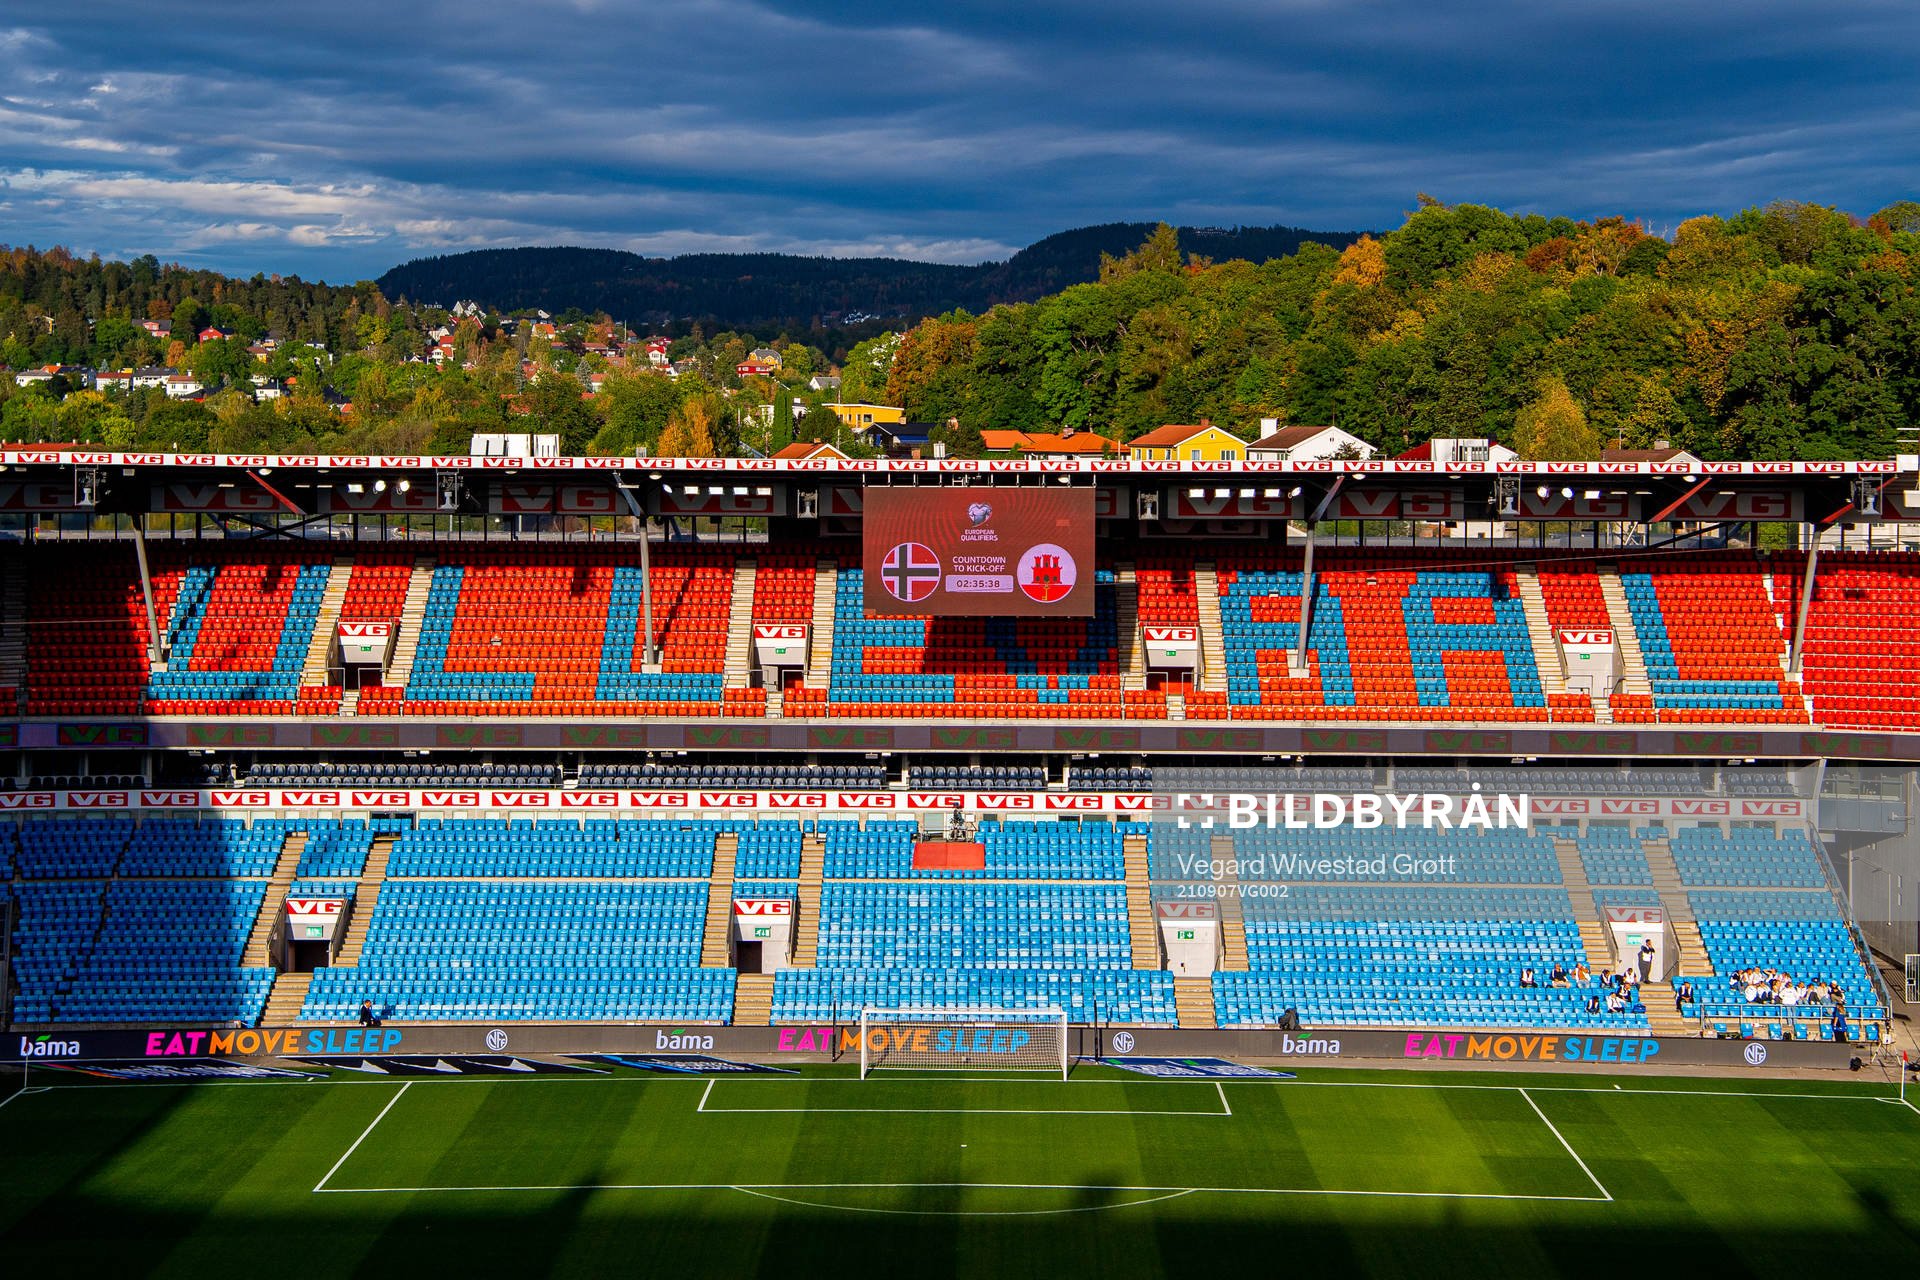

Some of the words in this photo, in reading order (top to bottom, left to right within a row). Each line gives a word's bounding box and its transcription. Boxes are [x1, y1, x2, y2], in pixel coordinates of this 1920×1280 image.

[19, 454, 59, 463] VG
[72, 454, 111, 463] VG
[124, 455, 163, 464] VG
[176, 456, 215, 465] VG
[228, 456, 266, 465] VG
[279, 457, 317, 466] VG
[331, 457, 369, 466] VG
[381, 457, 419, 466] VG
[433, 458, 470, 467] VG
[484, 458, 521, 467] VG
[535, 458, 572, 467] VG
[585, 459, 623, 468] VG
[636, 459, 673, 468] VG
[687, 459, 724, 468] VG
[738, 460, 775, 469] VG
[788, 460, 825, 469] VG
[839, 461, 876, 470] VG
[890, 461, 926, 470] VG
[940, 461, 977, 470] VG
[991, 461, 1028, 470] VG
[1041, 462, 1078, 471] VG
[1092, 462, 1129, 471] VG
[1142, 462, 1179, 471] VG
[1193, 462, 1230, 471] VG
[1243, 462, 1281, 471] VG
[1294, 462, 1331, 471] VG
[1345, 462, 1382, 471] VG
[1395, 462, 1433, 471] VG
[1446, 462, 1483, 471] VG
[1498, 463, 1535, 472] VG
[1549, 463, 1586, 472] VG
[1599, 463, 1637, 472] VG
[1651, 463, 1689, 472] VG
[1702, 463, 1740, 472] VG
[1754, 463, 1792, 472] VG
[1806, 463, 1843, 472] VG
[1858, 463, 1895, 472] VG
[166, 485, 274, 508] VG
[503, 486, 611, 510] VG
[1344, 490, 1448, 515] VG
[1683, 493, 1785, 516] VG
[953, 556, 1006, 564] COUNTDOWN
[957, 580, 1000, 588] 02:35:38
[341, 625, 387, 636] VG
[757, 627, 803, 638] VG
[1147, 629, 1193, 640] VG
[1562, 632, 1609, 643] VG
[63, 726, 144, 743] VG
[190, 727, 270, 743] VG
[316, 727, 395, 743] VG
[441, 727, 521, 743] VG
[565, 727, 643, 744] VG
[689, 728, 766, 744] VG
[812, 728, 888, 745] VG
[935, 729, 1012, 746] VG
[1057, 730, 1136, 746] VG
[1180, 730, 1260, 747] VG
[1306, 732, 1383, 748] VG
[1429, 733, 1506, 749] VG
[1554, 734, 1632, 750] VG
[1679, 735, 1757, 751] VG
[1805, 736, 1886, 752] VG
[71, 794, 125, 806] VG
[144, 793, 196, 806] VG
[215, 793, 266, 805] VG
[285, 793, 336, 805] VG
[355, 793, 406, 806] VG
[425, 793, 476, 806] VG
[495, 793, 545, 806] VG
[564, 793, 615, 806] VG
[634, 794, 684, 806] VG
[703, 794, 754, 807] VG
[772, 794, 823, 807] VG
[842, 794, 892, 807] VG
[911, 795, 961, 808] VG
[980, 796, 1030, 808] VG
[1049, 796, 1099, 809] VG
[1118, 796, 1168, 809] VG
[1534, 800, 1586, 812] VG
[1605, 801, 1656, 813] VG
[1675, 801, 1727, 814] VG
[1745, 802, 1797, 815] VG
[287, 901, 343, 914] VG
[737, 901, 790, 914] VG
[1159, 904, 1214, 917] VG
[1606, 909, 1662, 922] VG
[20, 1036, 80, 1056] bama
[146, 1032, 206, 1055] EAT
[209, 1030, 301, 1055] MOVE
[307, 1030, 402, 1053] SLEEP
[656, 1030, 714, 1049] bama
[778, 1029, 834, 1051] EAT
[837, 1029, 930, 1051] MOVE
[935, 1030, 1030, 1052] SLEEP
[1282, 1034, 1340, 1053] bama
[1404, 1034, 1464, 1057] EAT
[1466, 1036, 1559, 1059] MOVE
[1564, 1038, 1660, 1062] SLEEP
